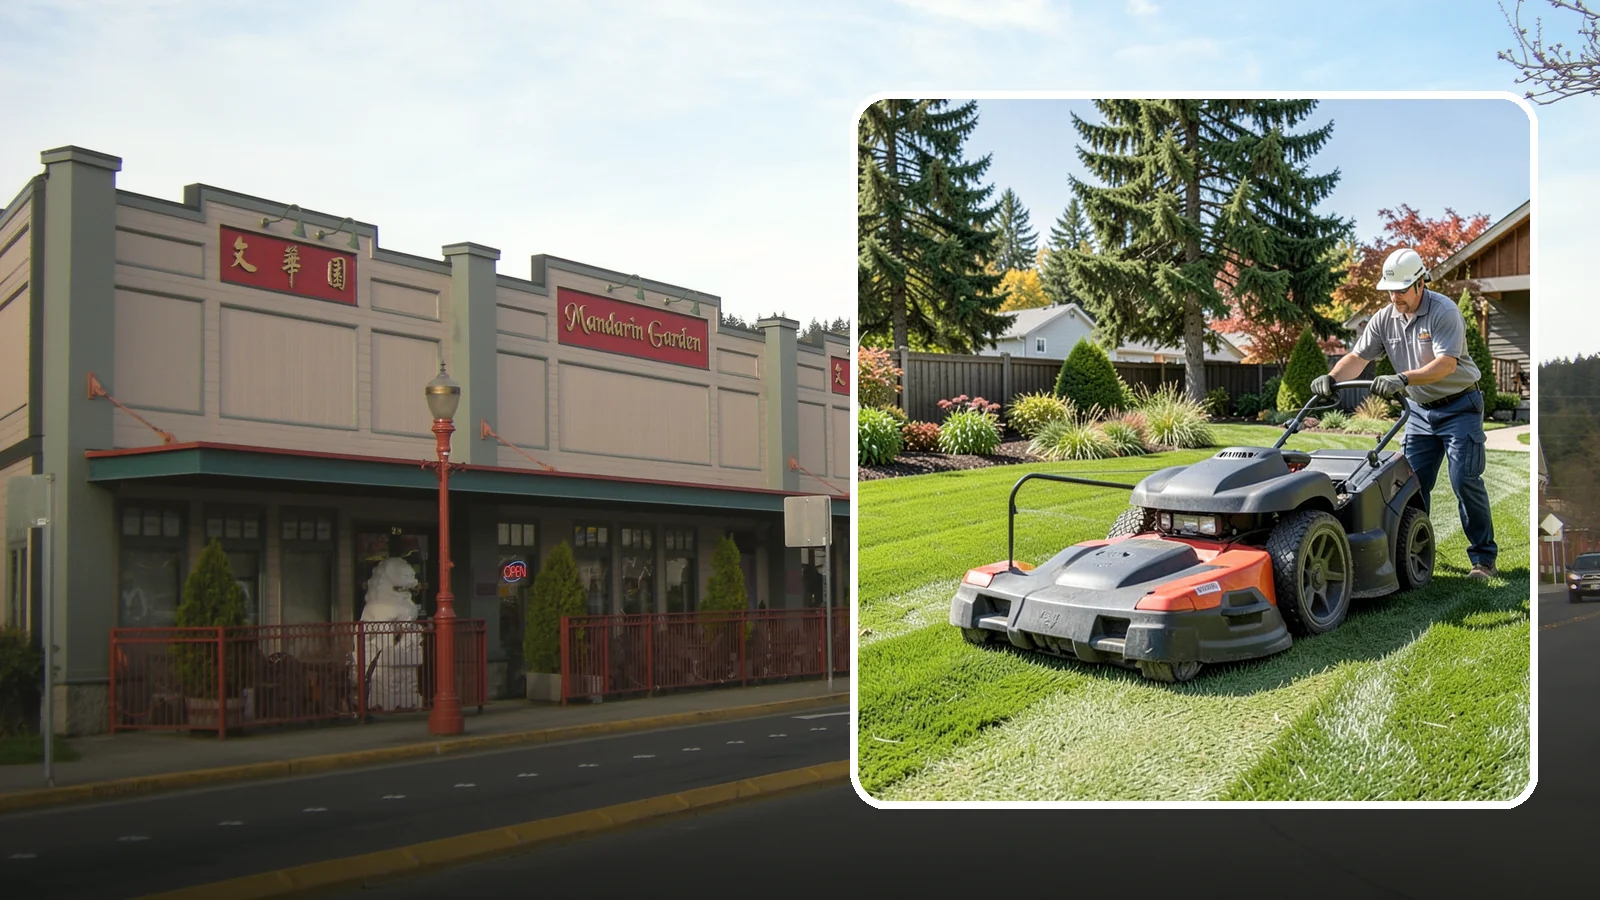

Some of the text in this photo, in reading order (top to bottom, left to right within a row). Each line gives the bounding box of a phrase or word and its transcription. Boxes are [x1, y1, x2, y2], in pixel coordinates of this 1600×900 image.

[230, 235, 346, 291] 文華園
[564, 302, 701, 352] Mandarin Garden
[503, 565, 527, 578] OPEN
